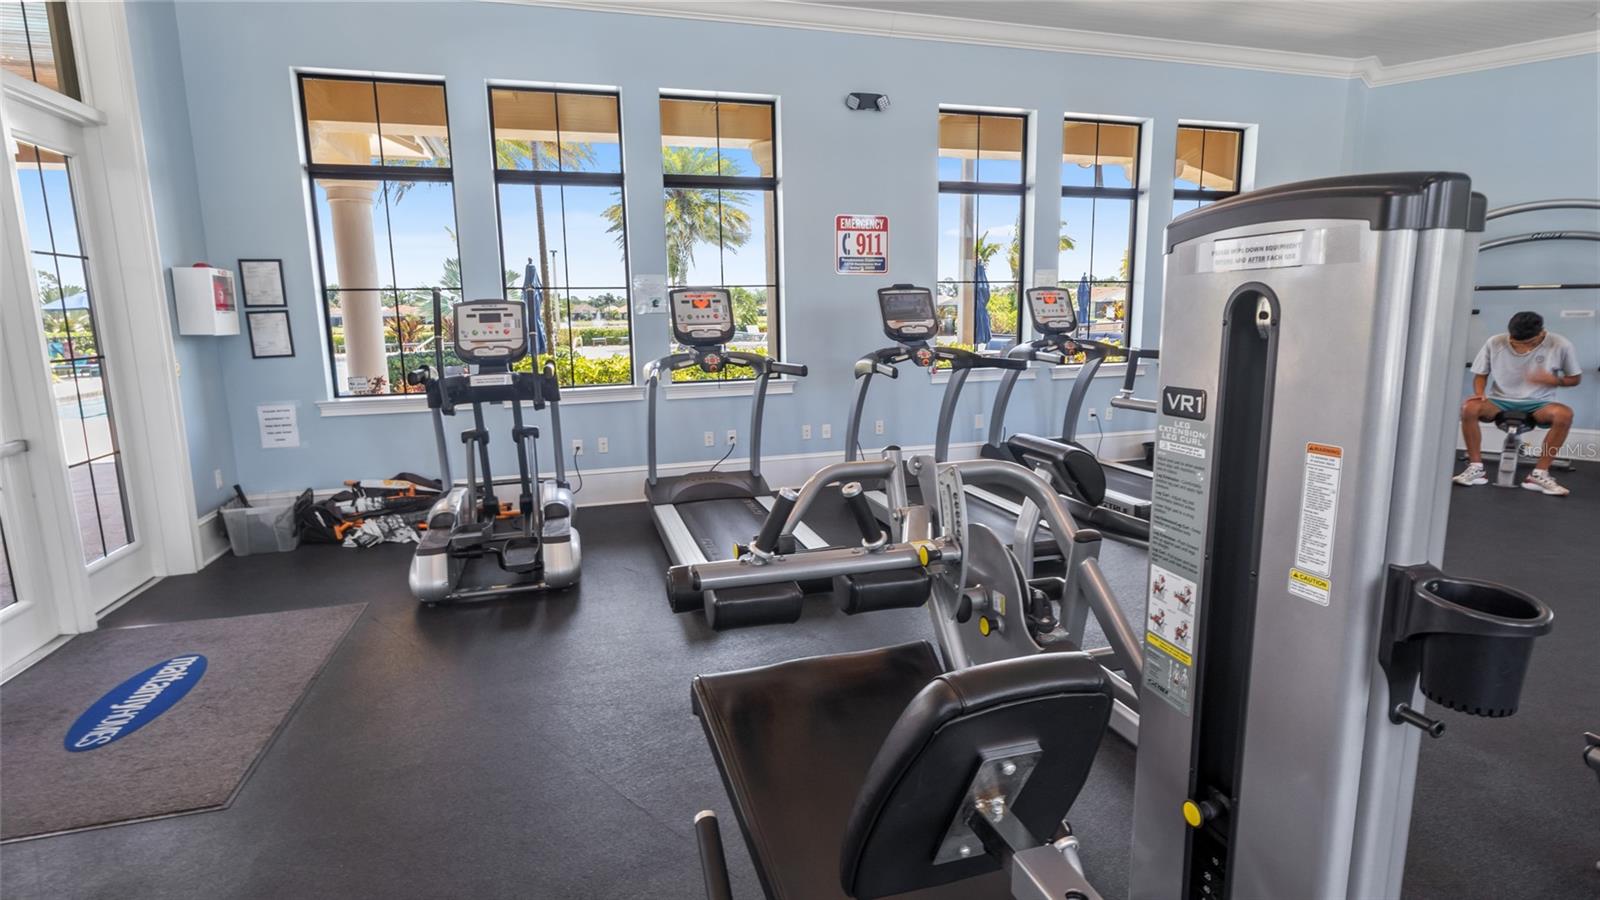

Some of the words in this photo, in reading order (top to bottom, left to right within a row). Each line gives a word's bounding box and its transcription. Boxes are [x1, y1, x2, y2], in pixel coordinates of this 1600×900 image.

[841, 218, 885, 230] EMERGENCY
[856, 232, 882, 256] 911
[1248, 255, 1265, 264] AFTER
[1167, 392, 1203, 414] VR1
[1174, 420, 1190, 429] LEG
[1162, 431, 1177, 441] LEG
[1180, 435, 1203, 447] CURL
[1299, 574, 1328, 588] CAUTION
